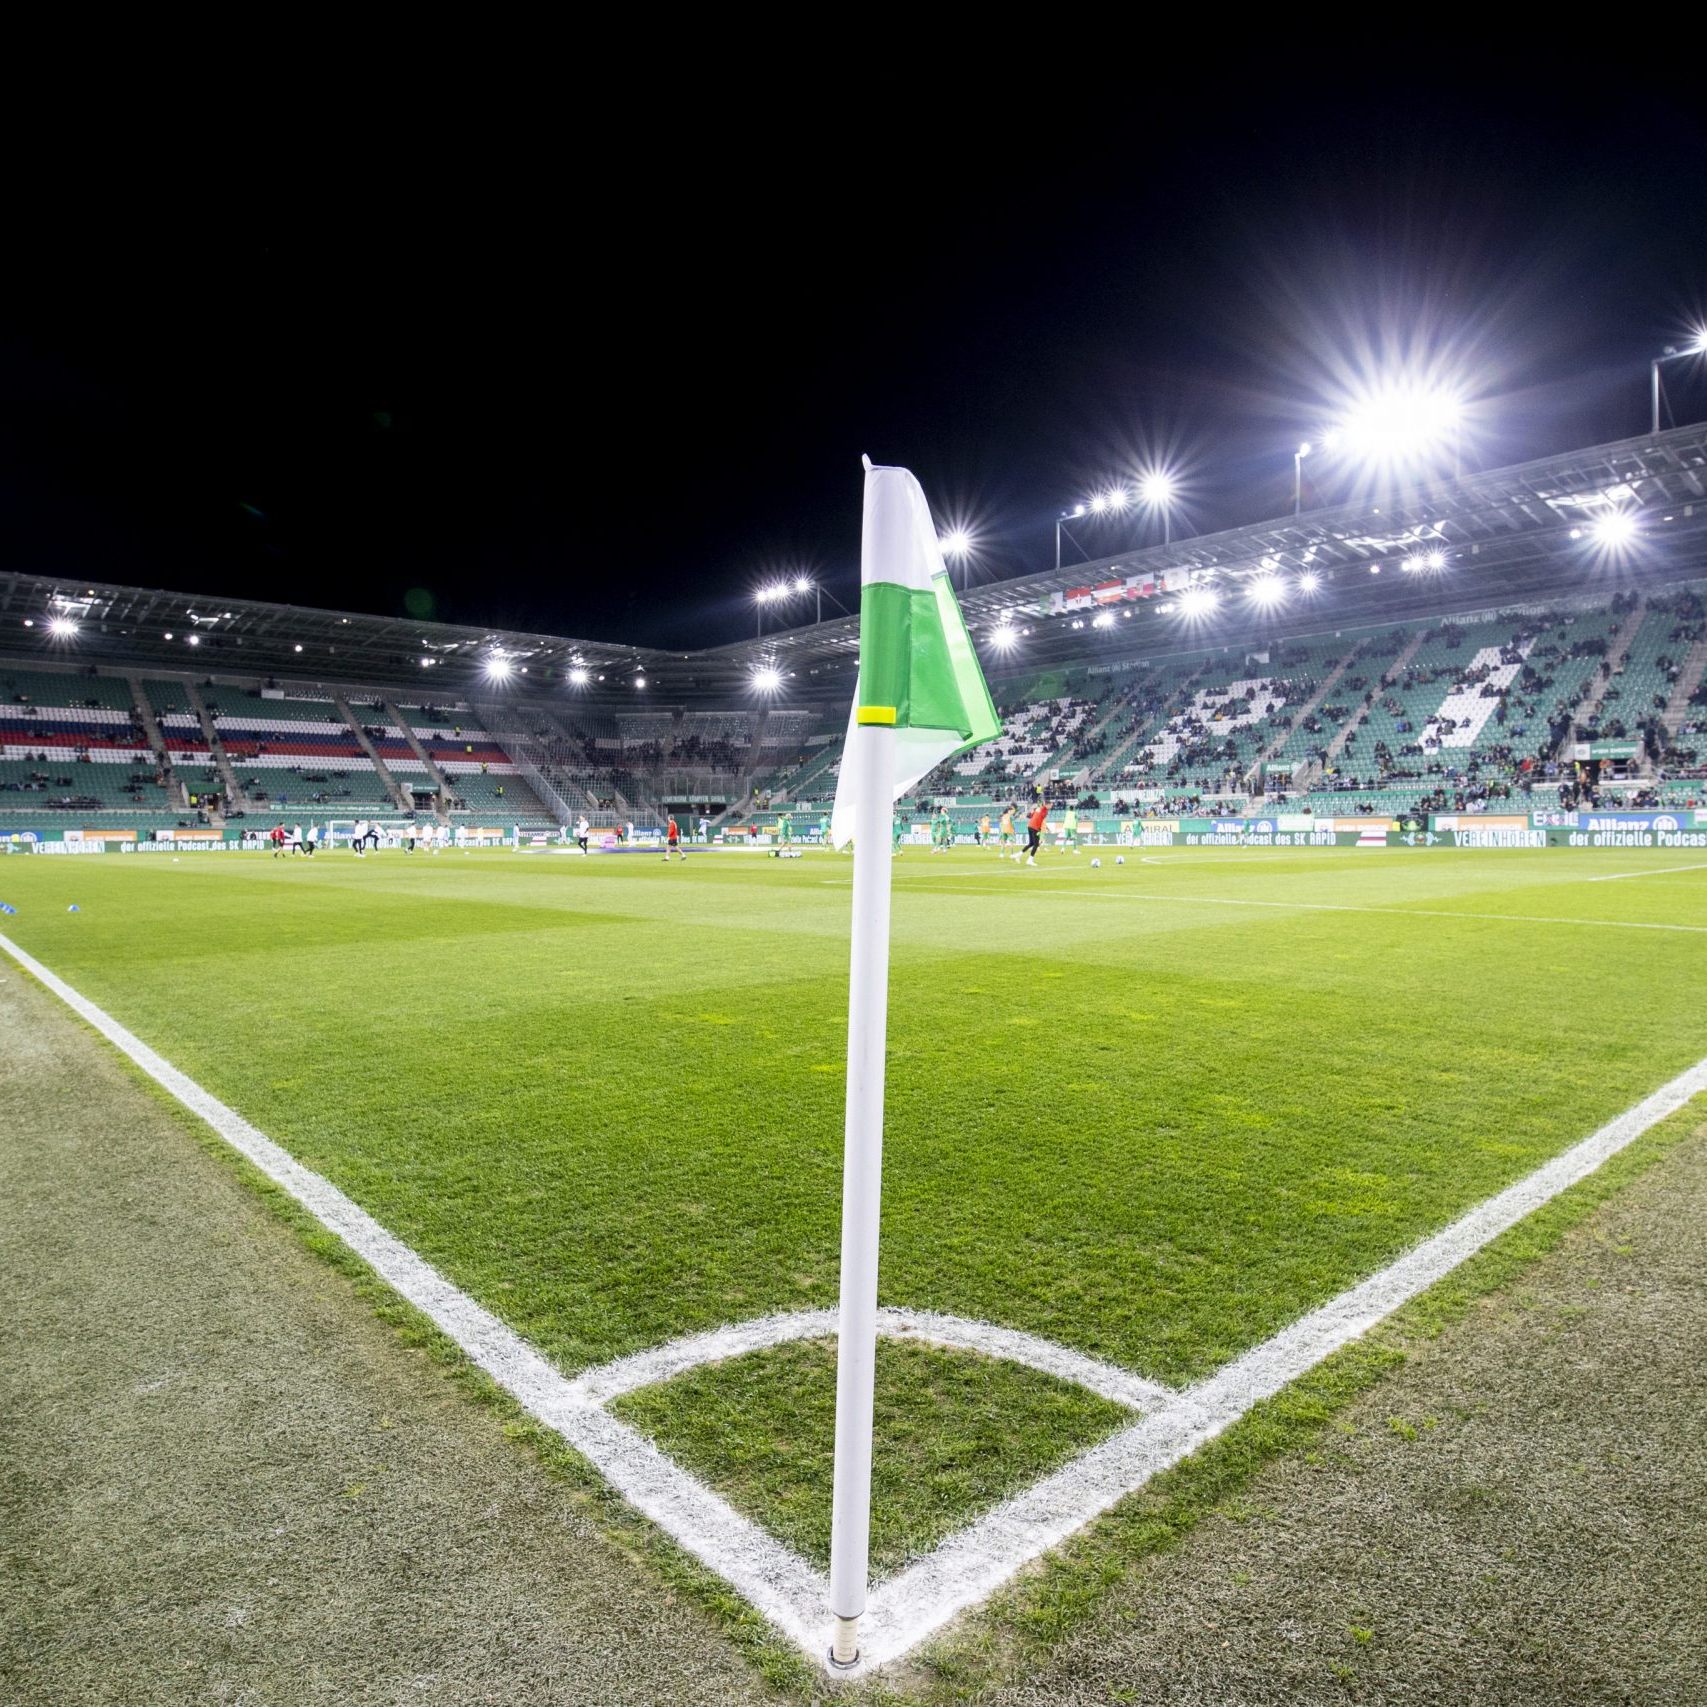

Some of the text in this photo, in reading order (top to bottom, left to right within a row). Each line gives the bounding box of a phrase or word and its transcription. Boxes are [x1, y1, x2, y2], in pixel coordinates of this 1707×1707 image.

[1186, 832, 1199, 845] der
[1201, 832, 1237, 846] offizielle
[1294, 832, 1306, 845] SK
[1310, 832, 1336, 845] RAPID
[1569, 830, 1707, 847] der offizielle Podcas
